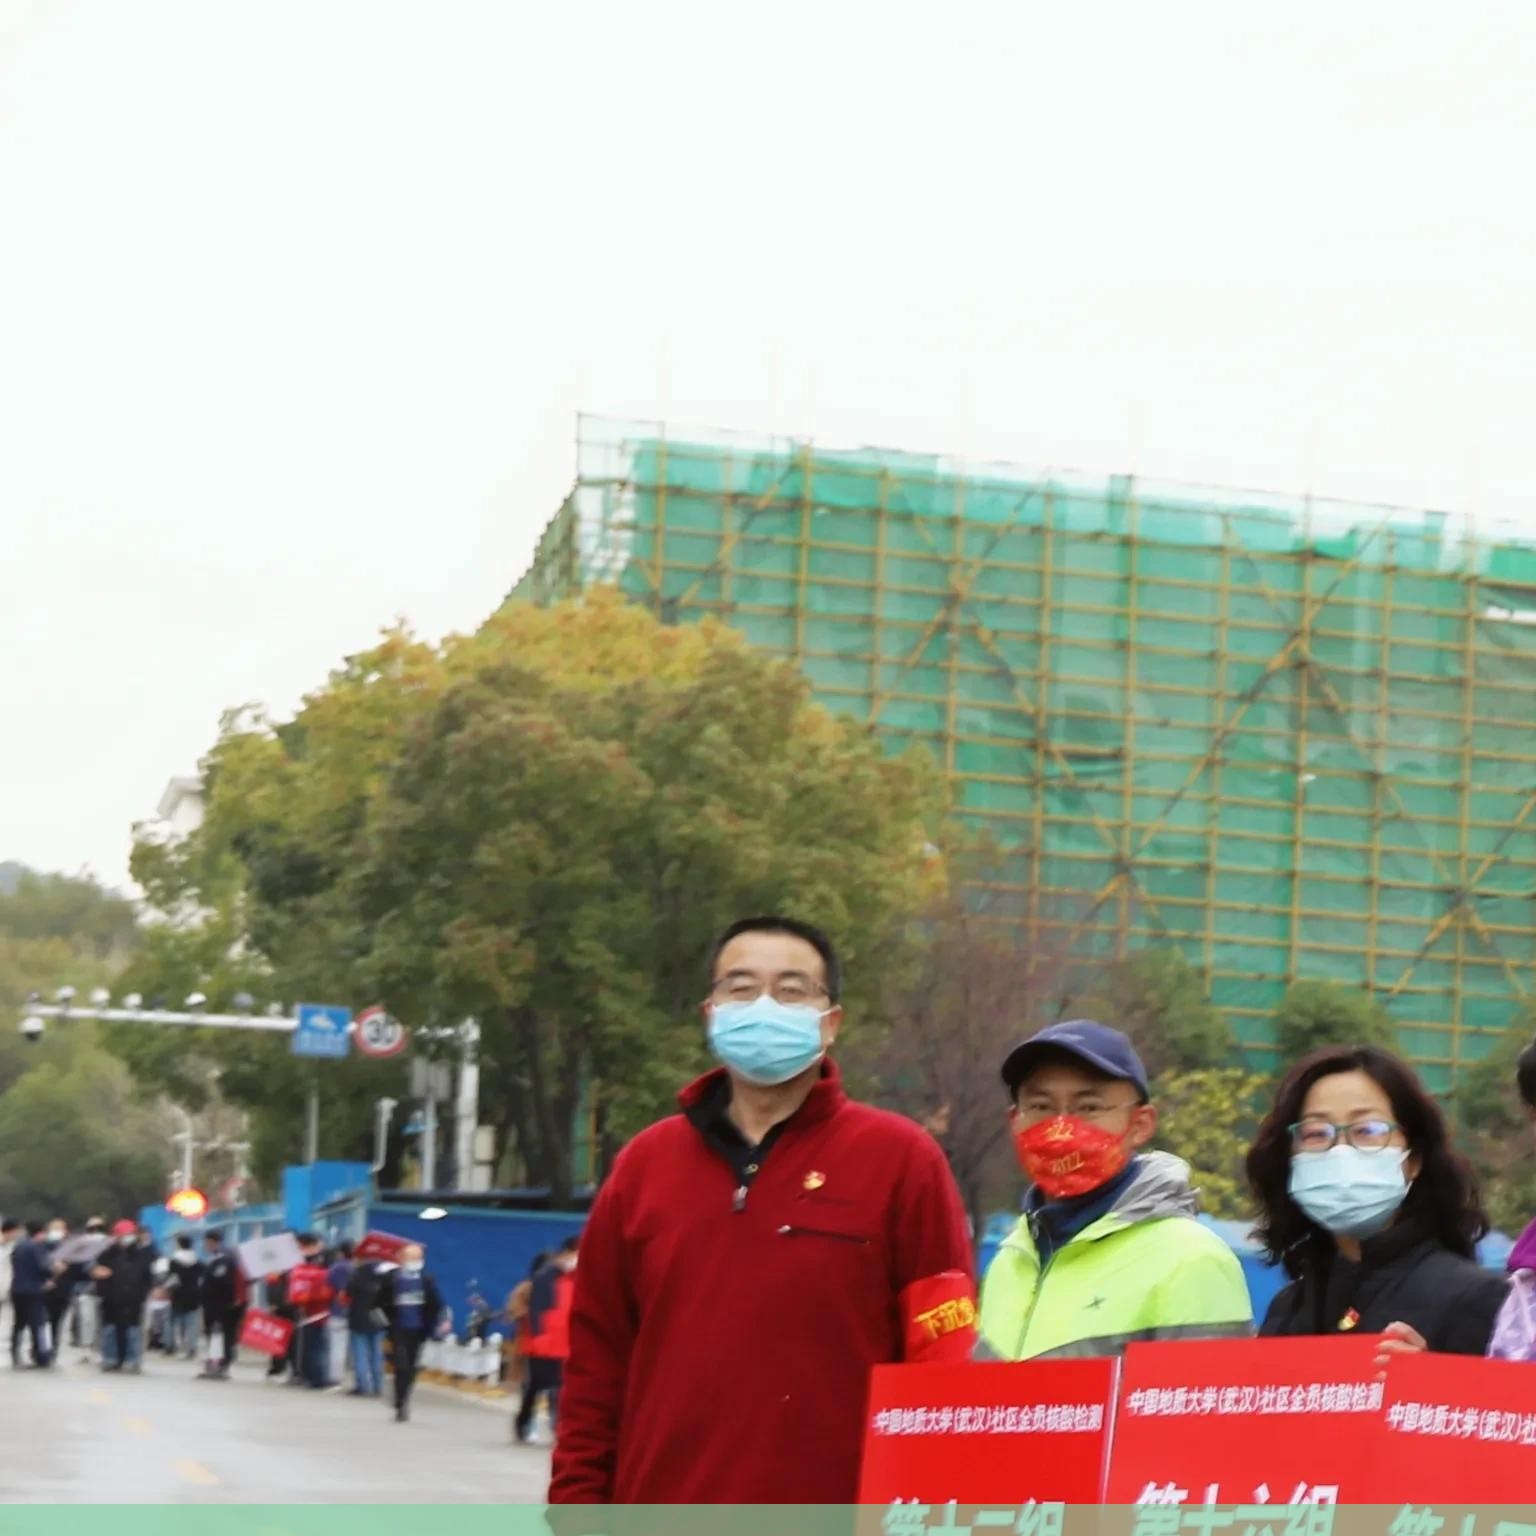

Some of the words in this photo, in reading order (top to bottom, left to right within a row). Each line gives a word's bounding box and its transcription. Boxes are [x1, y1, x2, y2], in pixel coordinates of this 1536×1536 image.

[1125, 1381, 1386, 1416] 中国地质大学(武汉)社区全员核酸检测
[872, 1402, 1103, 1435] 中国地质大学(武汉)社区全员核酸检测
